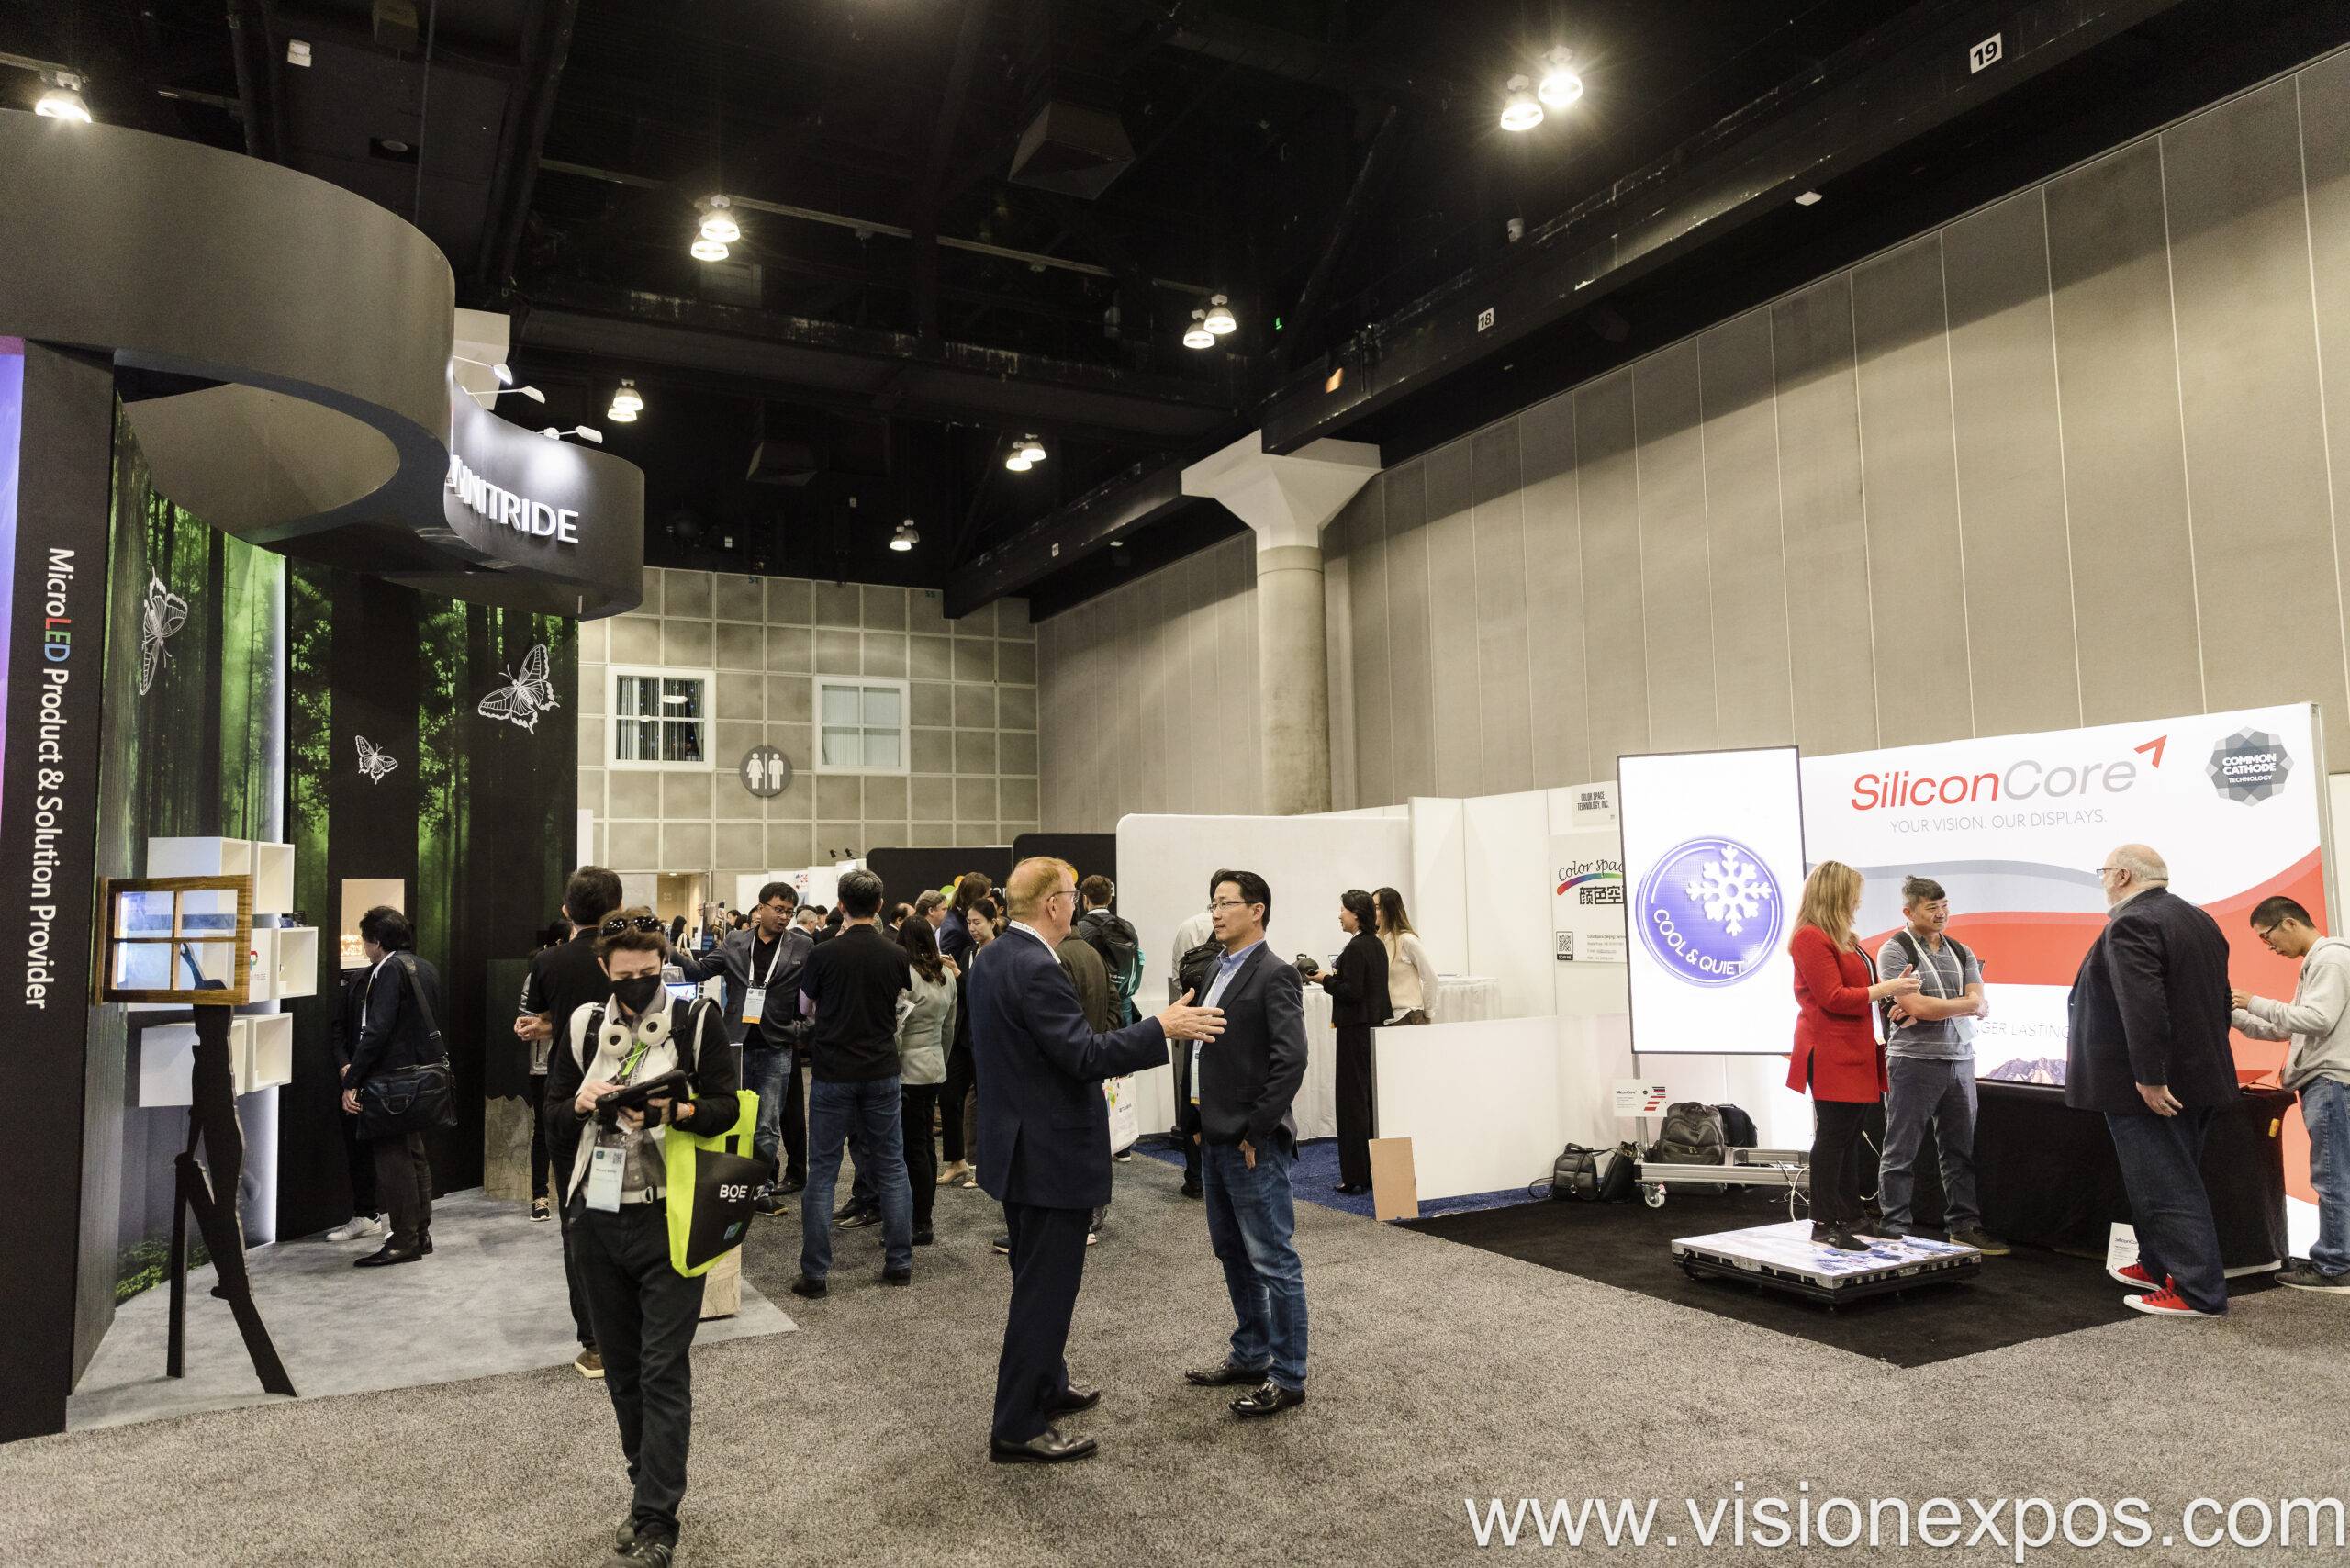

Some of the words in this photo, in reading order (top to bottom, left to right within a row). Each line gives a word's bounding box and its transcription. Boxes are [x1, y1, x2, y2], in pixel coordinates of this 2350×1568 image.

[1974, 41, 1998, 66] 19
[1480, 312, 1492, 328] 18
[45, 547, 75, 663] MicroLED
[38, 668, 69, 763] Product
[2222, 753, 2277, 767] COMMON
[2222, 762, 2277, 776] CATHODE
[38, 768, 65, 791] &
[1851, 759, 2137, 811] SiliconCore
[2228, 774, 2273, 784] TECHNOLOGY
[1890, 818, 1930, 834] YOUR
[1932, 816, 1987, 833] VISION.
[1991, 813, 2027, 830] OUR
[2031, 809, 2108, 827] DISPLAYS.
[31, 795, 63, 899] Solution
[1558, 860, 1594, 882] Color
[1653, 909, 1687, 958] COOL
[1685, 949, 1699, 965] &
[1699, 956, 1745, 976] QUIET
[25, 904, 56, 1011] Provider
[719, 1184, 748, 1201] BOE
